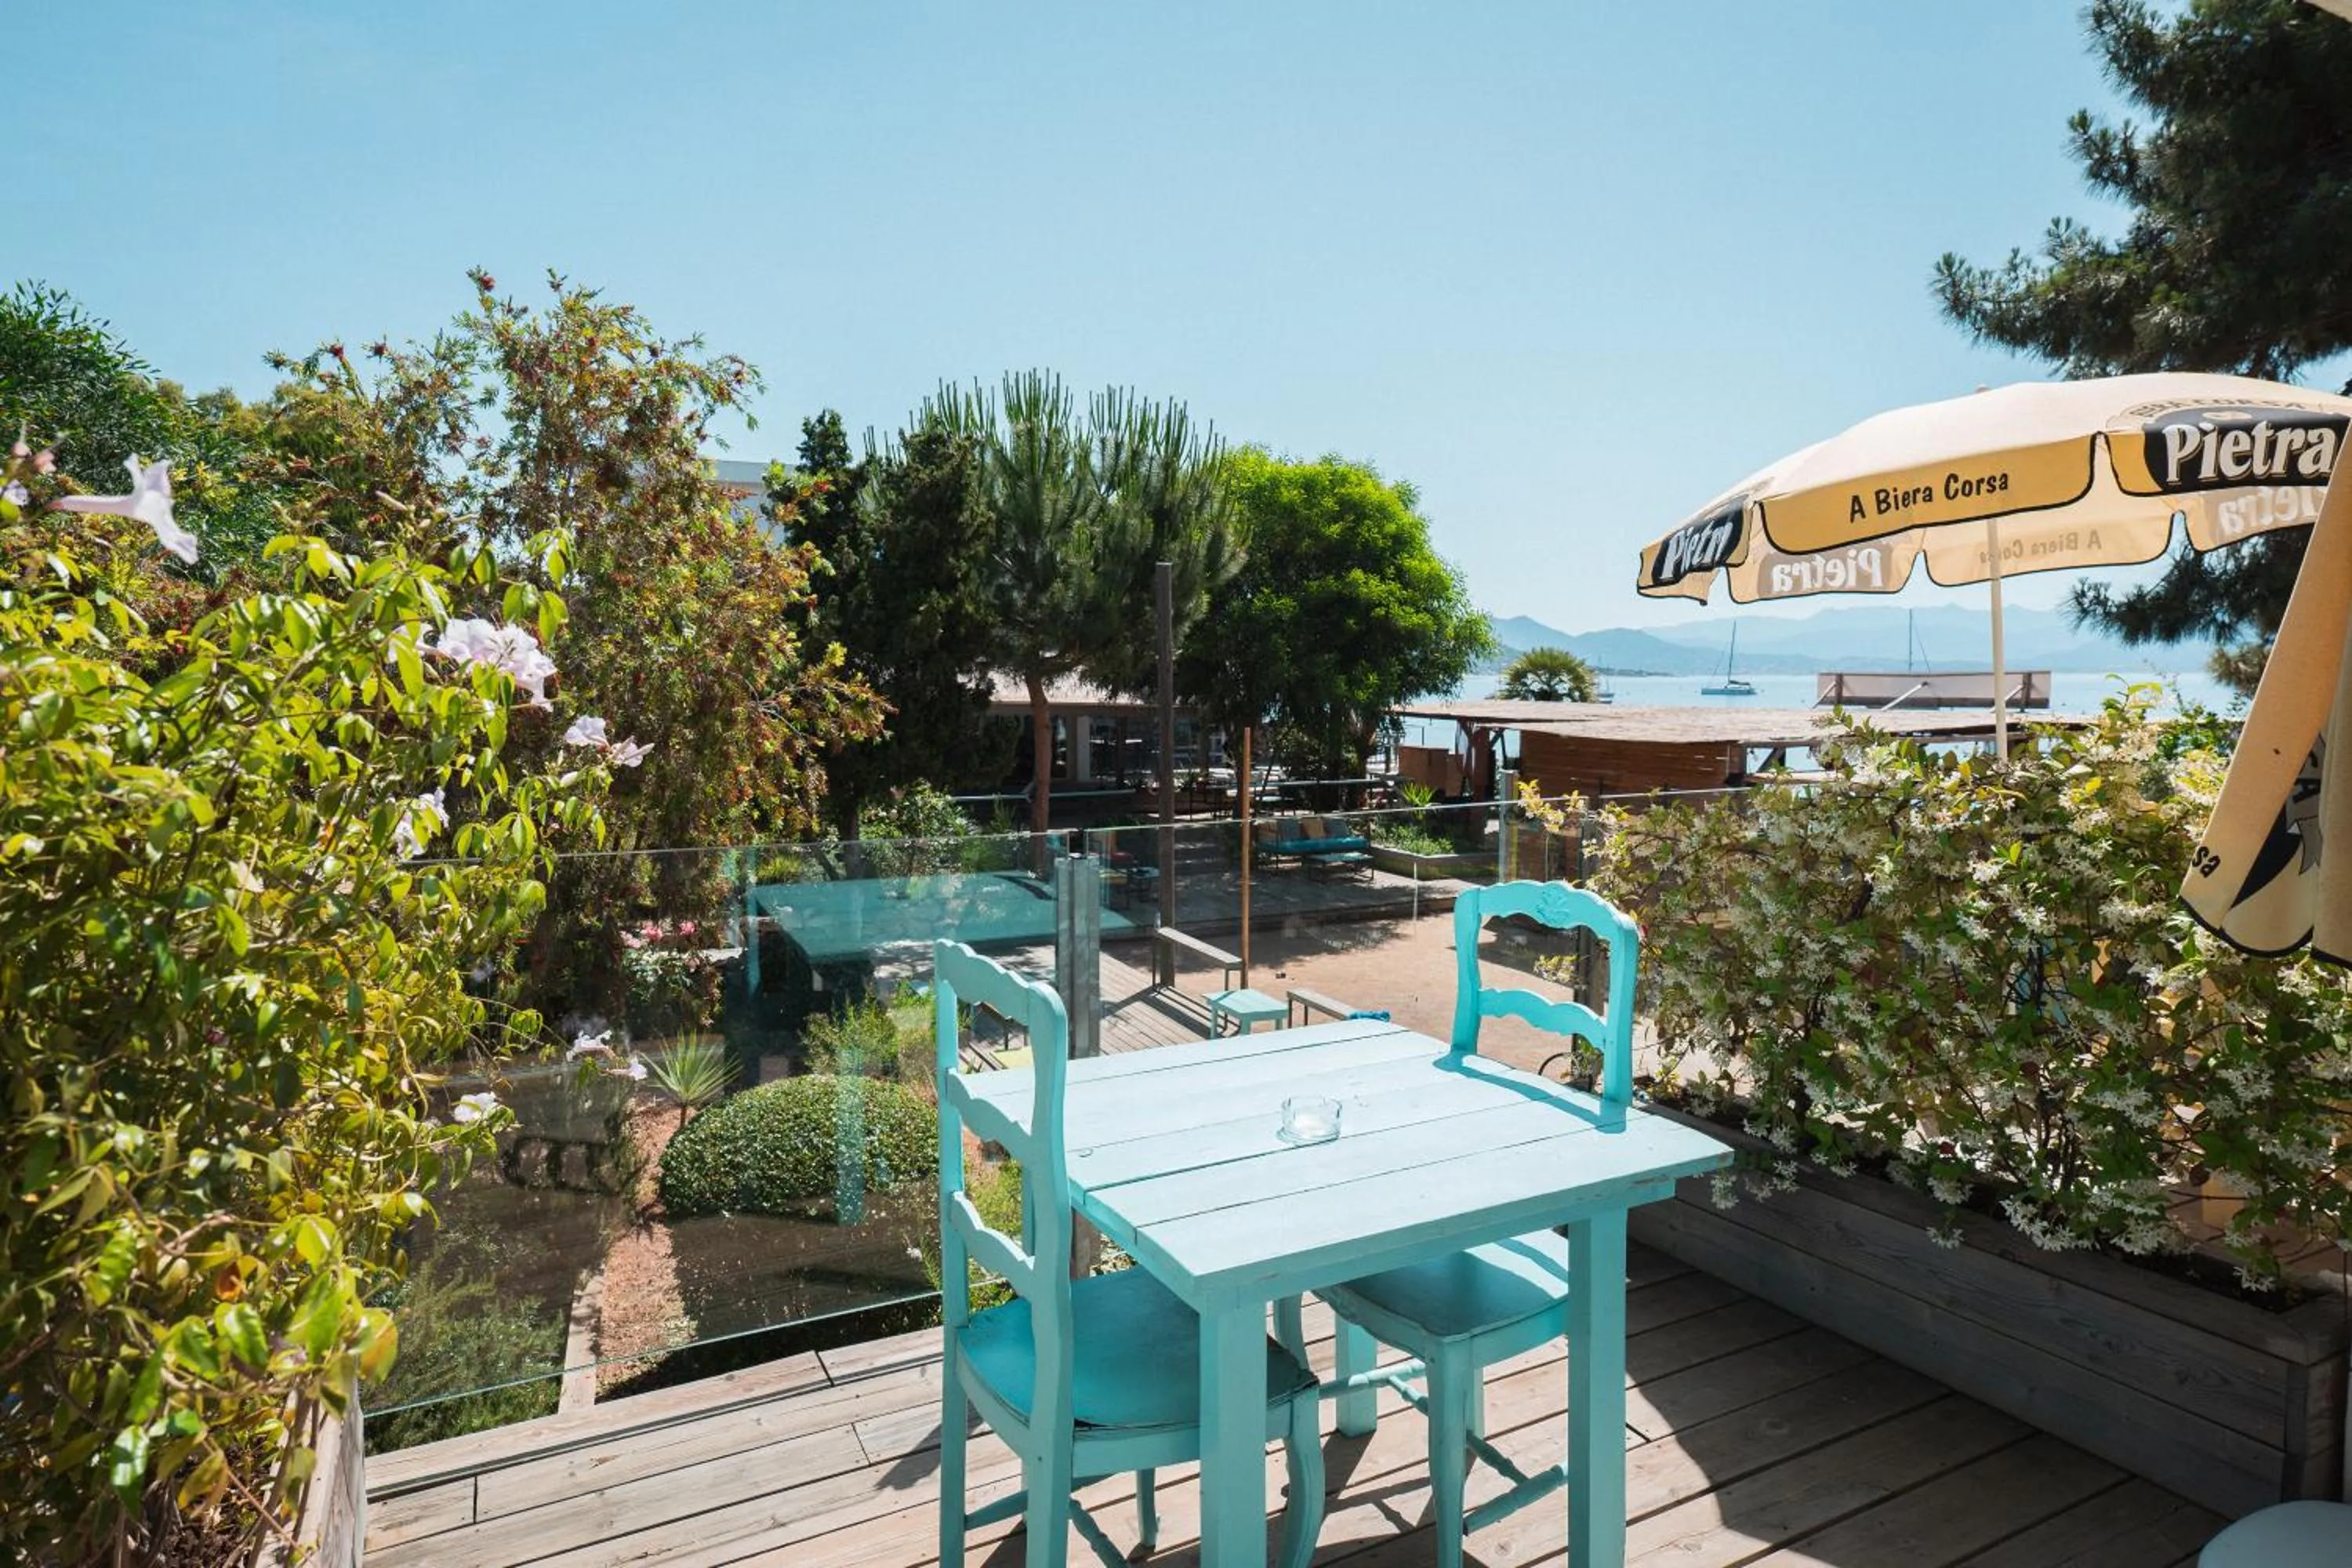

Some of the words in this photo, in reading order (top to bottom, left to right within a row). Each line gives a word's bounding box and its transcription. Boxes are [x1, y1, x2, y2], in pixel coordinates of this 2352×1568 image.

[2161, 420, 2336, 486] Pietra
[1849, 495, 1867, 524] A
[1875, 485, 1934, 516] Biera
[1944, 472, 2009, 501] Corsa
